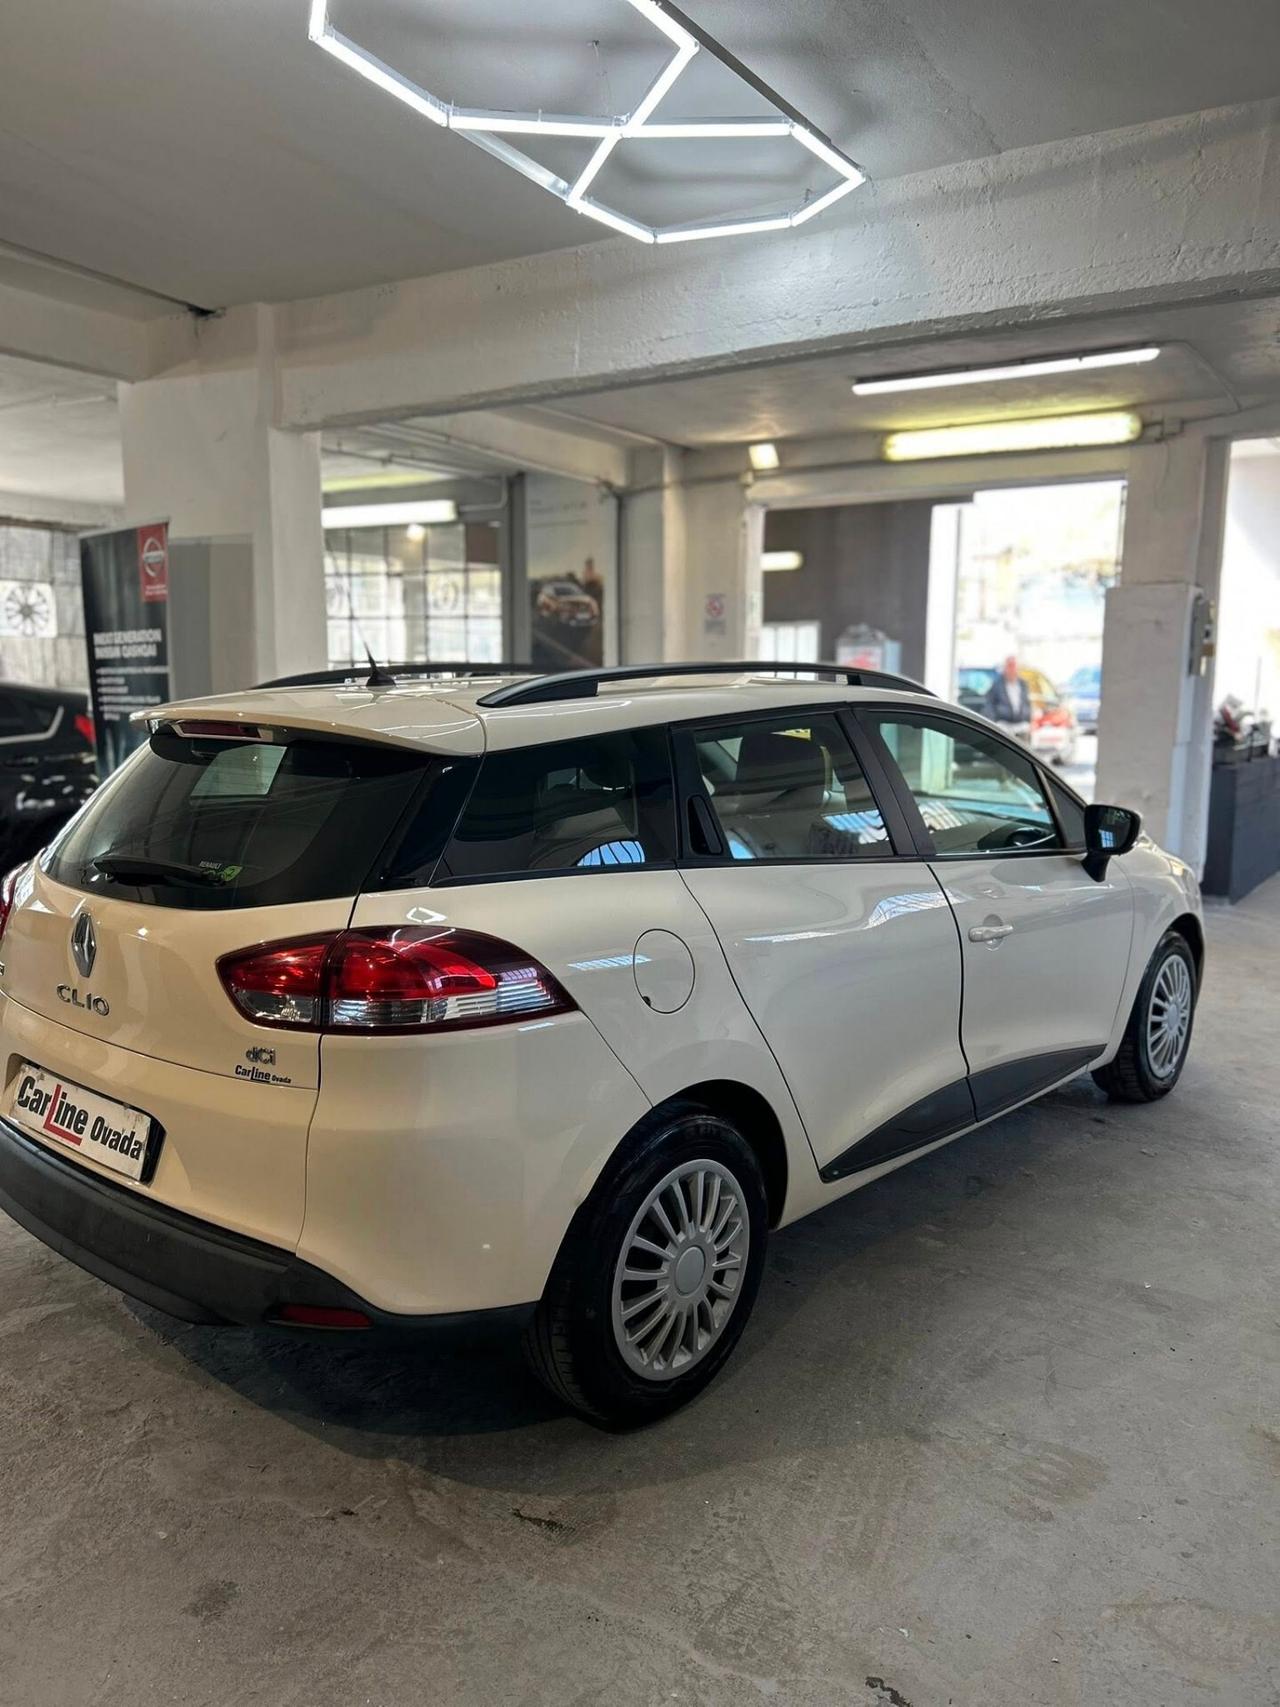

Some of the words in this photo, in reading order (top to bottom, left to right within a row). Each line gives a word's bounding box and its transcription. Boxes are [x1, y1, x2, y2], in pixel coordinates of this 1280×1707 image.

[56, 983, 110, 1017] CLIO
[235, 1064, 271, 1084] CarLine
[17, 1075, 89, 1146] CarLine
[90, 1115, 144, 1161] Ovada
